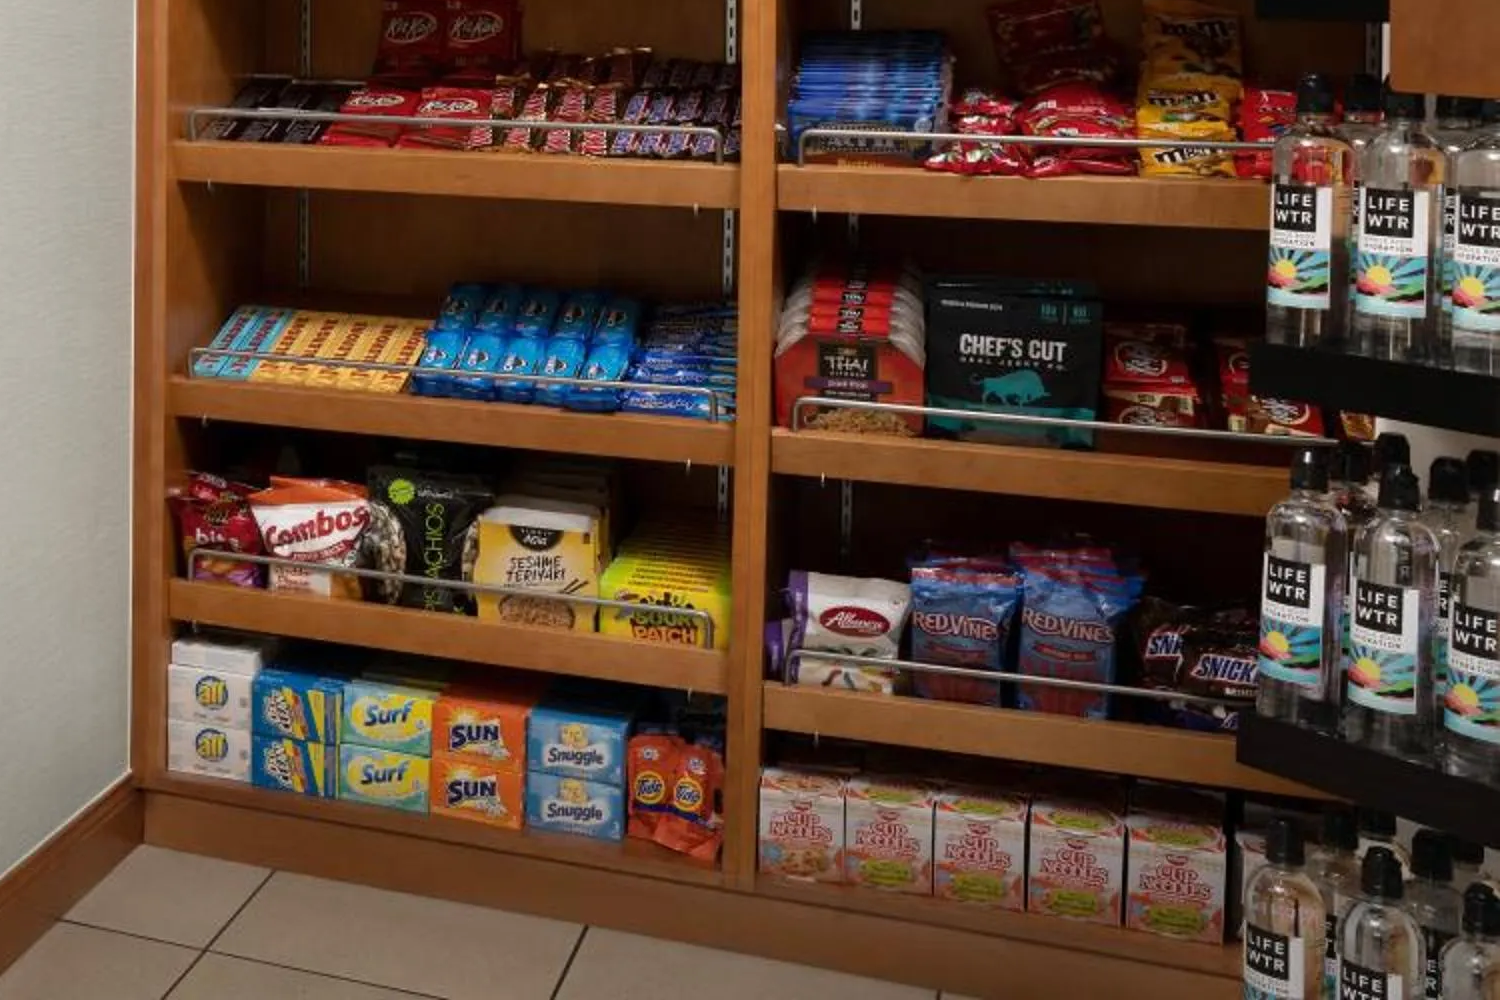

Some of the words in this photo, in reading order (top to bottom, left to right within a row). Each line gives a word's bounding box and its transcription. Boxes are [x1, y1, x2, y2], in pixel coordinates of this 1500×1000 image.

[1276, 191, 1313, 208] LIFE
[1367, 196, 1411, 212] LIFE
[1274, 209, 1312, 225] WTR
[1366, 214, 1411, 230] WTR
[959, 333, 1023, 359] CHEF'S
[1028, 338, 1068, 364] CUT
[824, 356, 869, 372] THAI
[263, 503, 371, 548] Combos
[509, 555, 563, 571] SESAME
[1269, 562, 1307, 584] LIFE
[506, 567, 566, 583] TERIYAKI
[1267, 580, 1307, 601] WTR
[1358, 585, 1399, 610] LIFE
[911, 610, 949, 632] RED
[951, 614, 999, 641] VINES
[1021, 608, 1058, 632] RED
[1060, 615, 1115, 643] VINES
[1357, 608, 1399, 628] WTR
[1454, 609, 1498, 634] LIFE
[632, 625, 697, 645] PATCH
[1454, 632, 1498, 653] WTR
[198, 680, 227, 706] all
[363, 700, 413, 727] Surf
[198, 733, 227, 760] all
[450, 723, 499, 749] SUN
[547, 747, 605, 766] Snuggle
[360, 760, 410, 785] Surf
[448, 779, 497, 804] SUN
[546, 802, 604, 822] Snuggle
[1248, 932, 1286, 955] LIFE
[1342, 966, 1385, 994] LIFE
